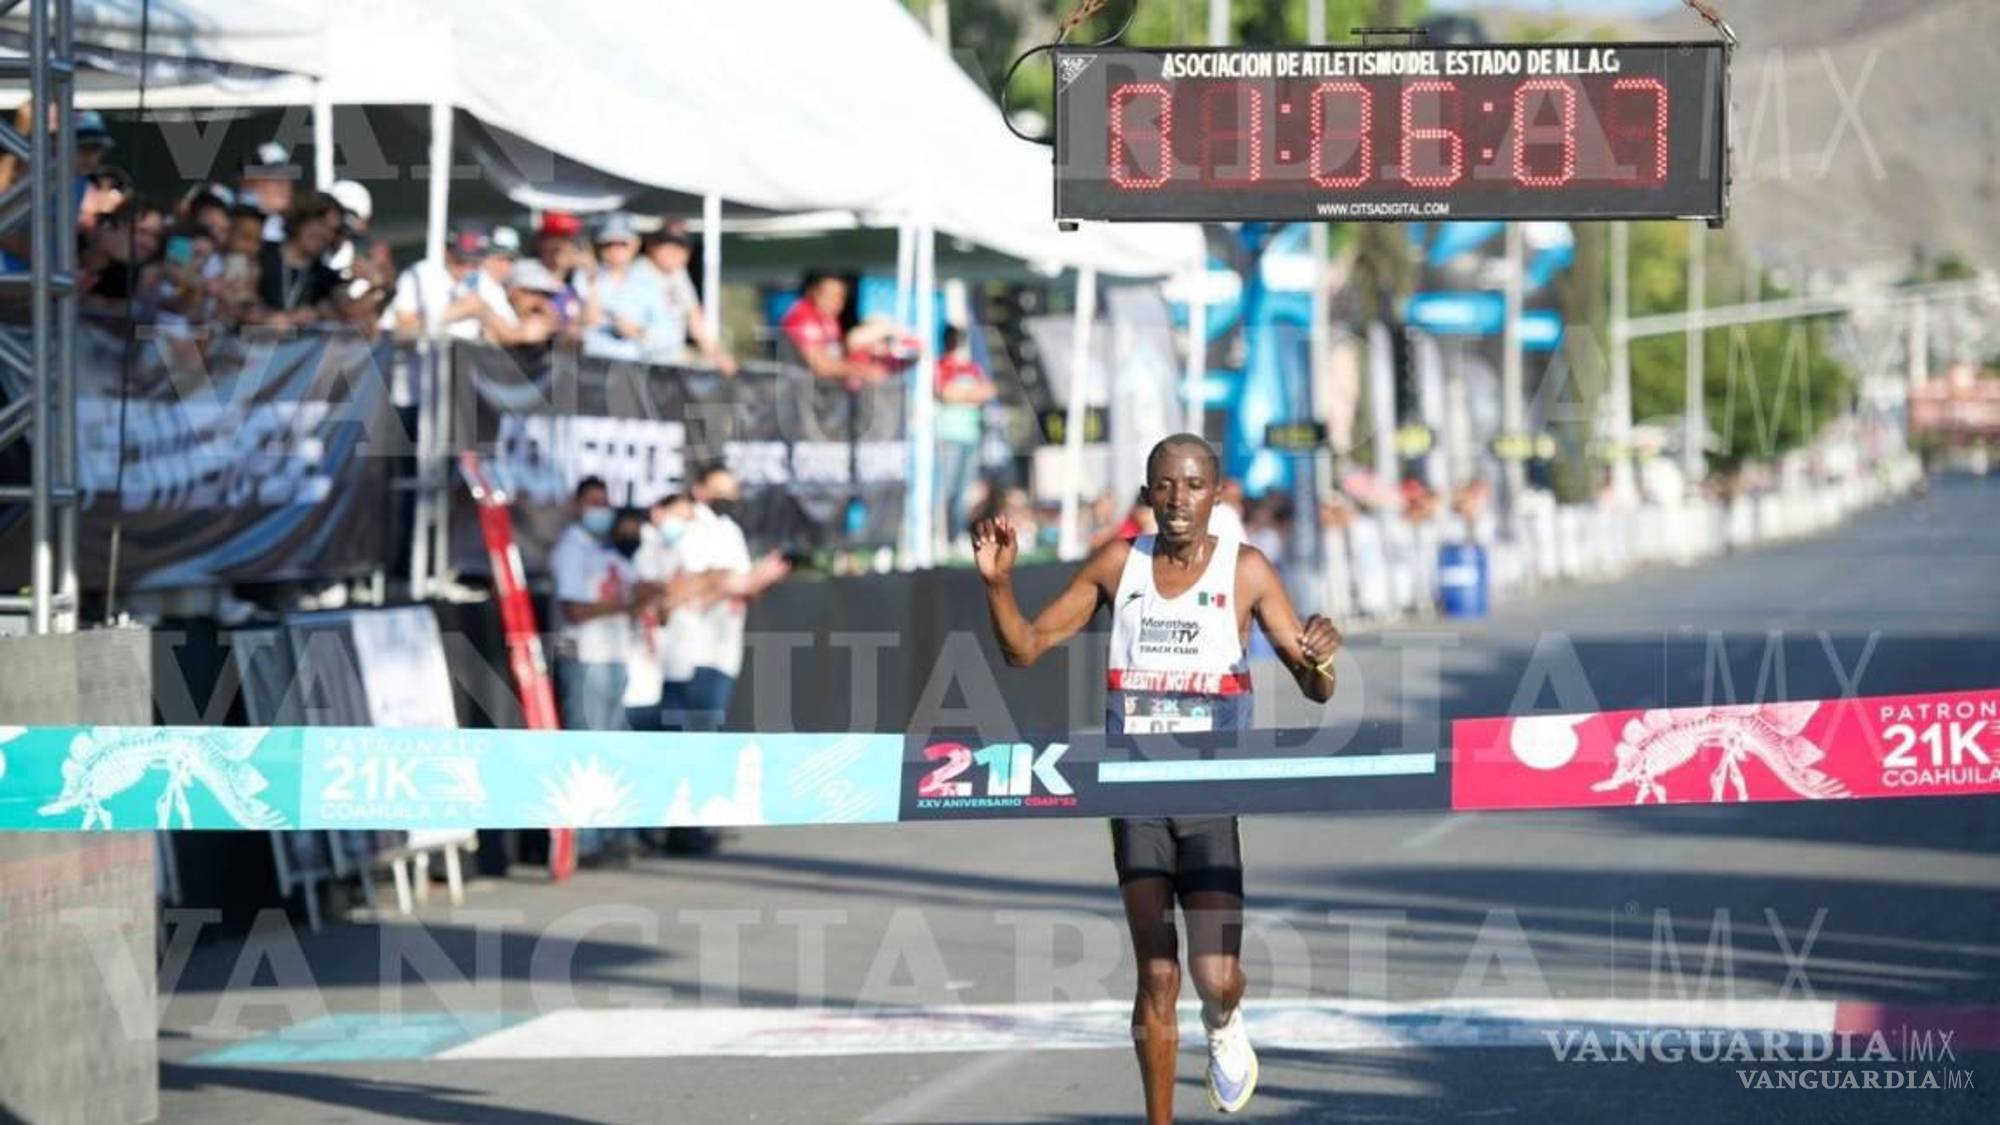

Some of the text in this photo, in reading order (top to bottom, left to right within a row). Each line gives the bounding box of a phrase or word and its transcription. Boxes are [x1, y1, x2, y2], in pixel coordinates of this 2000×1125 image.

[1161, 52, 1272, 79] ASOCIACION
[1276, 53, 1300, 77] DE
[1302, 51, 1405, 77] ATLETISMO
[1407, 51, 1440, 75] DEL
[1445, 51, 1521, 75] ESTADO
[1527, 50, 1553, 74] DE
[1110, 80, 1668, 190] 01:06:07
[1316, 202, 1449, 216] WWW.CITSADIGITAL.COM
[1882, 720, 1992, 769] 21K
[321, 756, 419, 801] 21K
[917, 742, 1075, 797] 21K
[916, 799, 941, 808] XXV
[942, 798, 1022, 808] ANIVERSARIO
